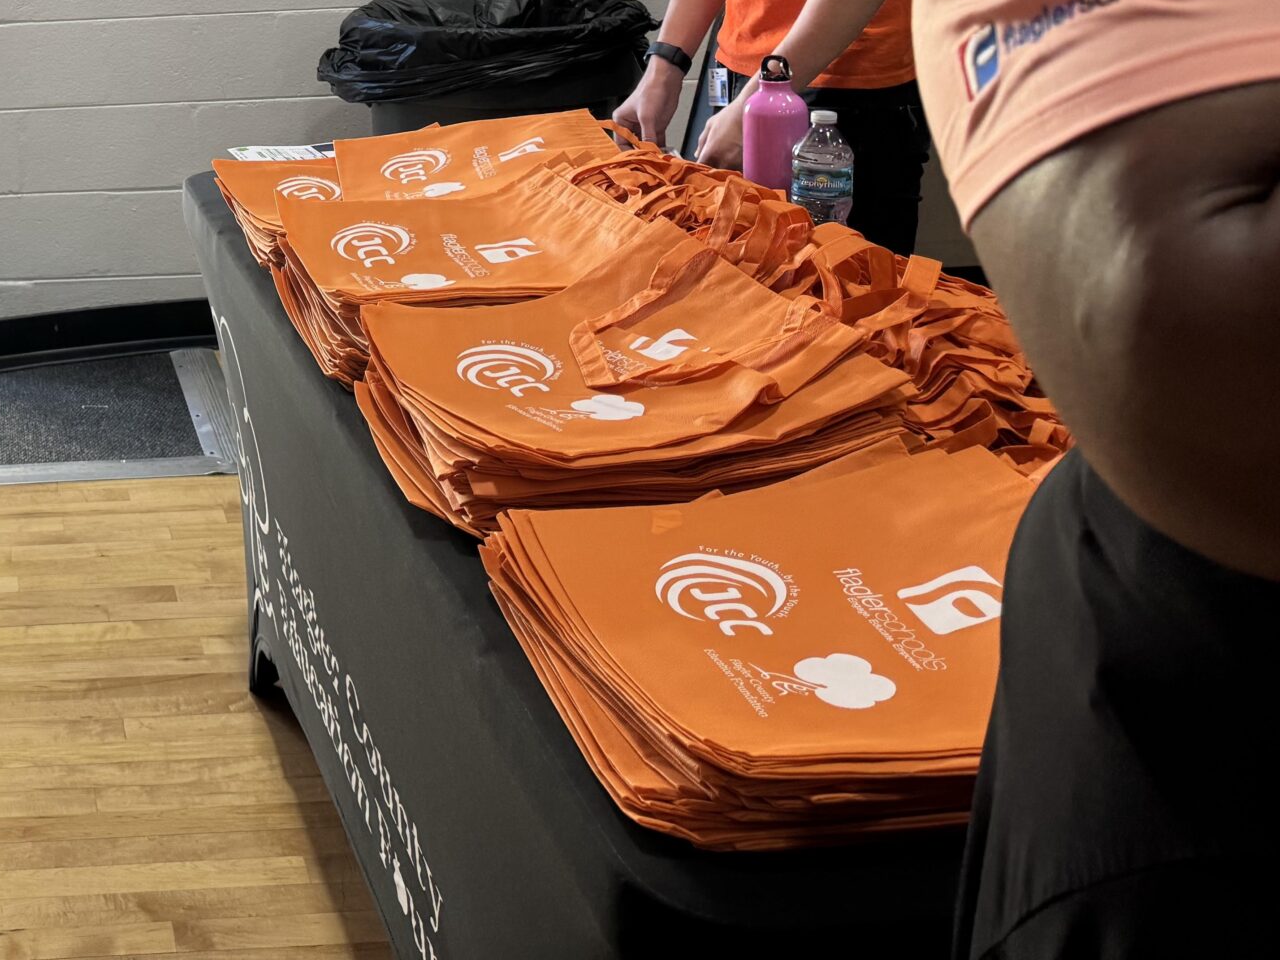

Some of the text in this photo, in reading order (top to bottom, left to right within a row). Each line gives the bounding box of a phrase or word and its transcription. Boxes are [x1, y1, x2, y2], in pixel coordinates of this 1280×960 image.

[351, 236, 396, 269] JCC
[482, 366, 550, 398] JCC
[698, 545, 719, 553] For
[724, 548, 745, 558] the
[789, 585, 801, 597] the
[690, 587, 774, 637] JCC
[832, 567, 947, 671] flaglerschools
[750, 677, 776, 705] County
[346, 674, 443, 933] County
